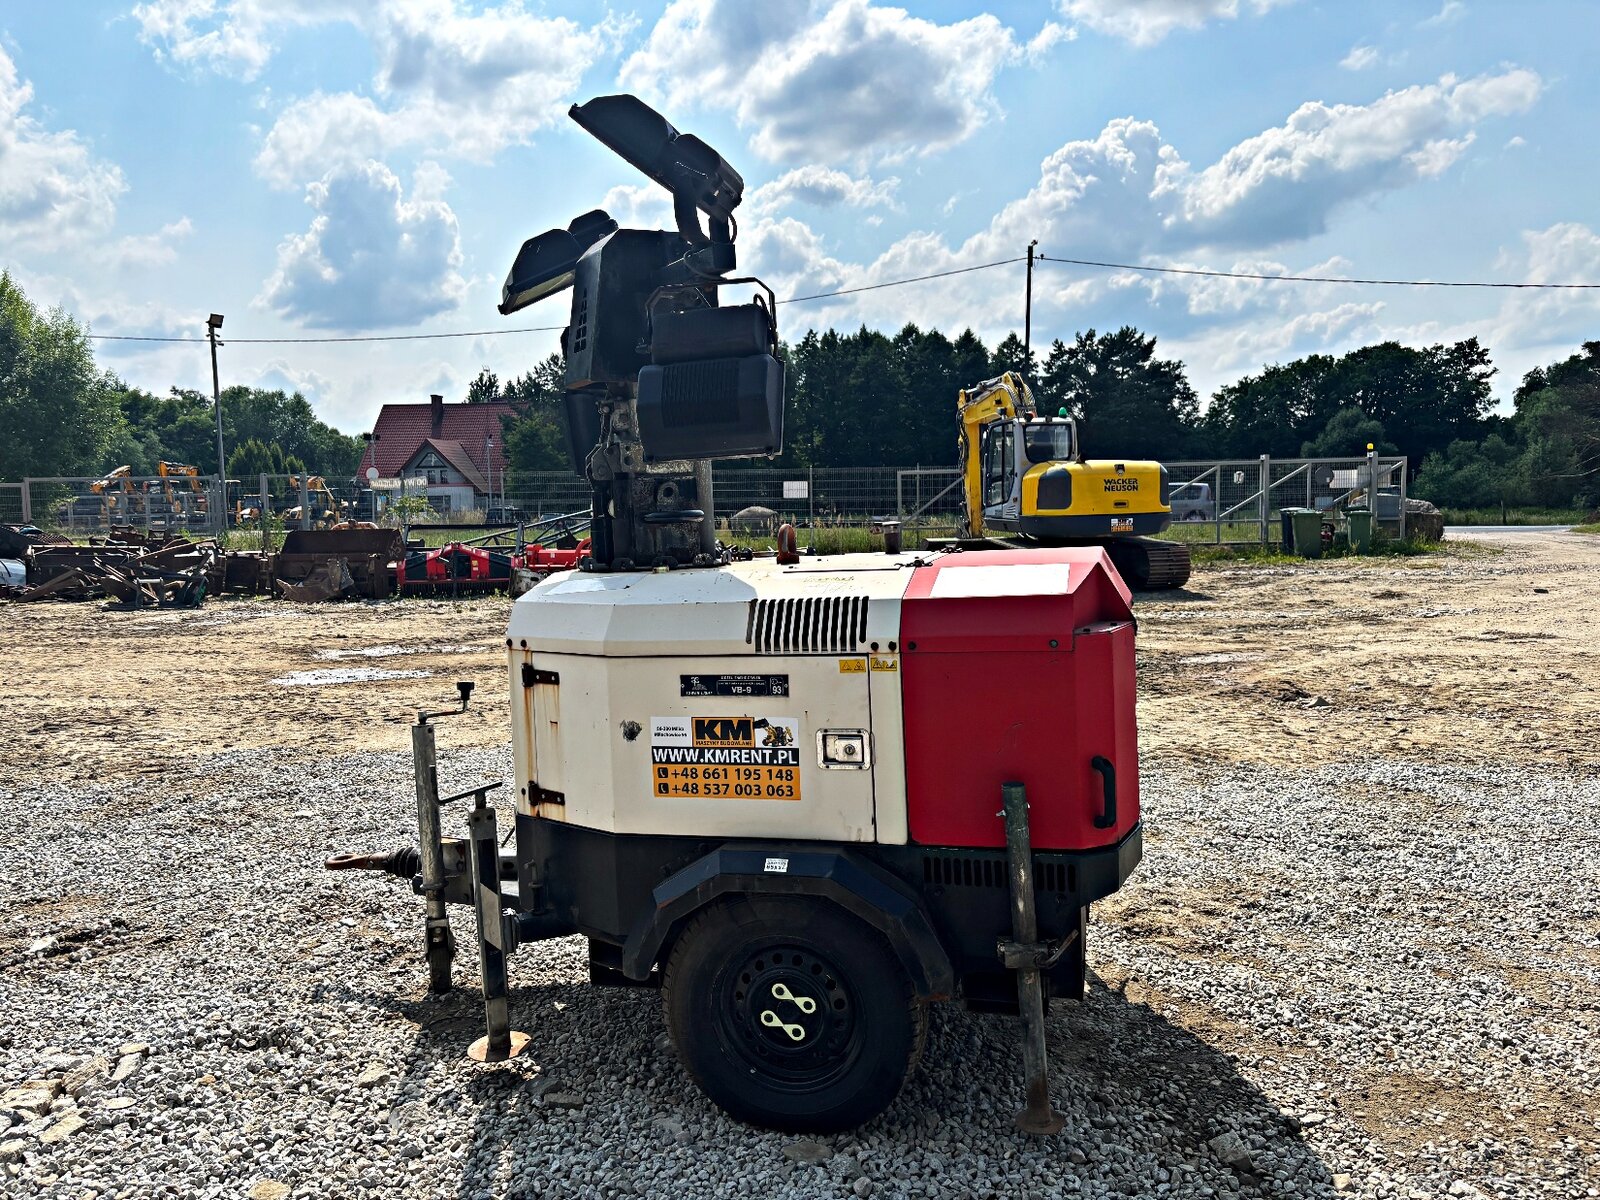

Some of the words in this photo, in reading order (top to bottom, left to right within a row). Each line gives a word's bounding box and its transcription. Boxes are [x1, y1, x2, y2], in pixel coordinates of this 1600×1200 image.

[731, 686, 752, 694] VB-9
[772, 685, 782, 694] 93
[694, 719, 752, 740] KM
[653, 748, 798, 764] WWW.KMRENT.PL
[671, 767, 699, 779] +48
[702, 768, 728, 780] 661
[734, 769, 761, 781] 195
[766, 769, 794, 781] 148
[671, 782, 699, 794] +48
[703, 783, 730, 795] 537
[734, 784, 761, 796] 003
[766, 785, 794, 797] 063
